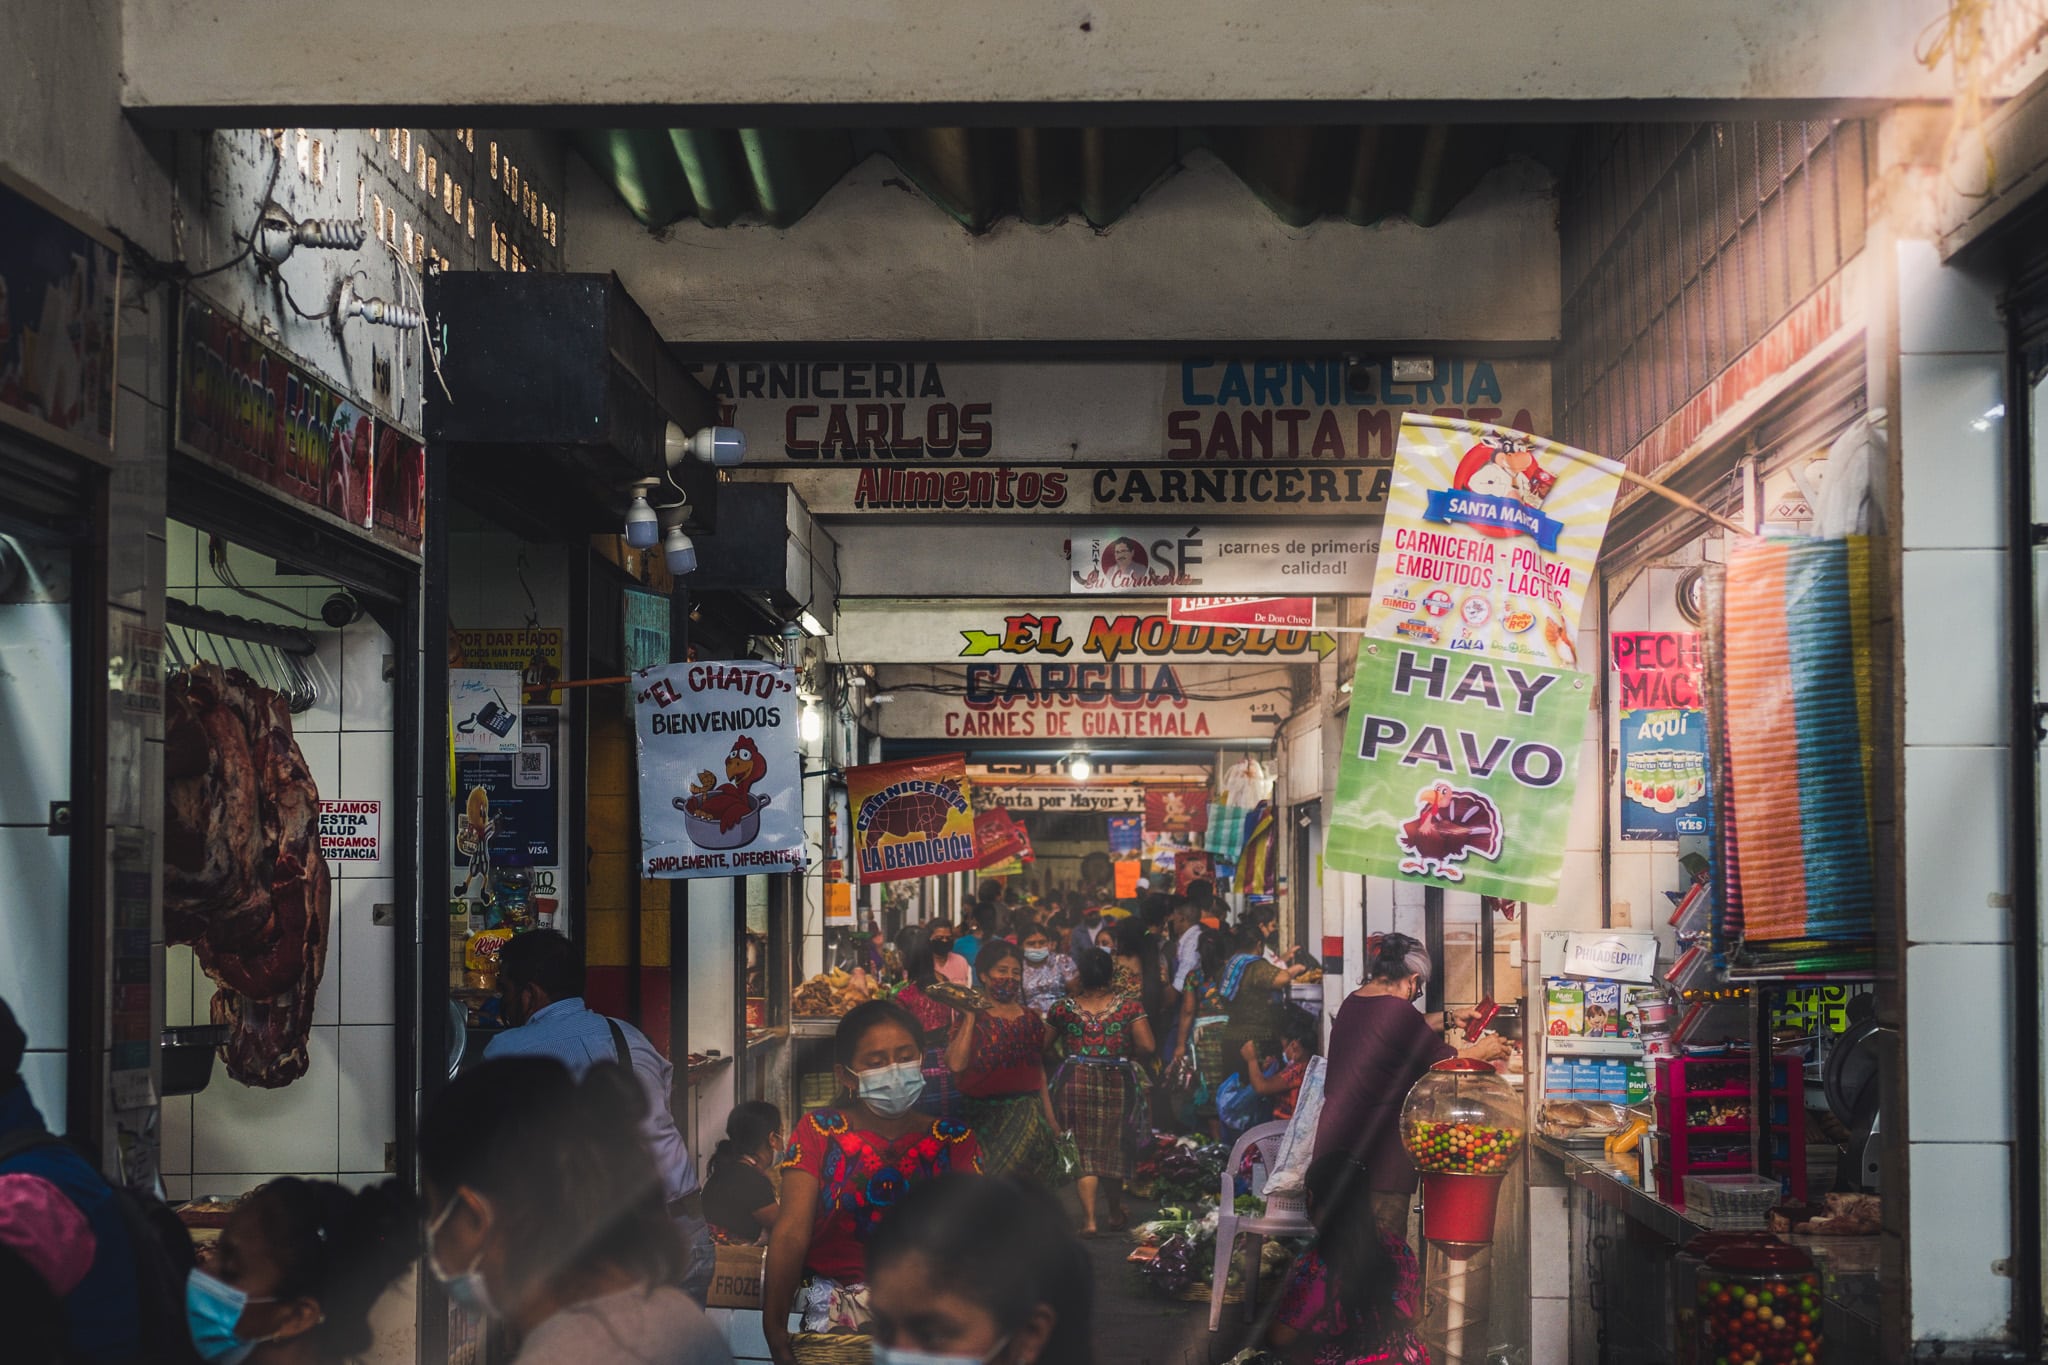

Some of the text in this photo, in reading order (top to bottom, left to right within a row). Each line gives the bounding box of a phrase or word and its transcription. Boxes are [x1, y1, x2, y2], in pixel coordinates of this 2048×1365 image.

[785, 402, 992, 459] CARLOS
[1167, 409, 1346, 459] SANTA
[854, 467, 1068, 509] Alimentos
[1448, 498, 1497, 519] SANTA
[1218, 542, 1280, 558] ¡carnes
[1286, 540, 1306, 554] de
[1395, 528, 1494, 564] CARNICERÍA
[1281, 561, 1347, 575] calidad!
[1395, 554, 1492, 590] EMBUTIDOS
[1255, 613, 1265, 622] De
[1268, 614, 1285, 624] Don
[464, 648, 490, 658] UCHOS
[486, 633, 512, 646] DAR
[1001, 613, 1311, 664] EL MODELO
[964, 661, 1188, 710] CARGUA
[1392, 650, 1559, 715] HAY
[652, 706, 780, 735] BIENVENIDOS
[944, 711, 1211, 737] CARNES DE GUATEMALA
[1638, 712, 1689, 742] AQUÍ
[1359, 715, 1565, 787] PAVO
[856, 780, 969, 832] CARNICERÍA
[1039, 794, 1066, 811] por
[1071, 793, 1118, 811] Mayor
[1679, 820, 1703, 831] YES
[320, 837, 377, 848] ENGAMOS
[528, 846, 550, 855] VISA
[861, 847, 884, 873] LA
[884, 832, 974, 871] BENDICIÓN
[1575, 945, 1644, 968] PHILADELPHIA
